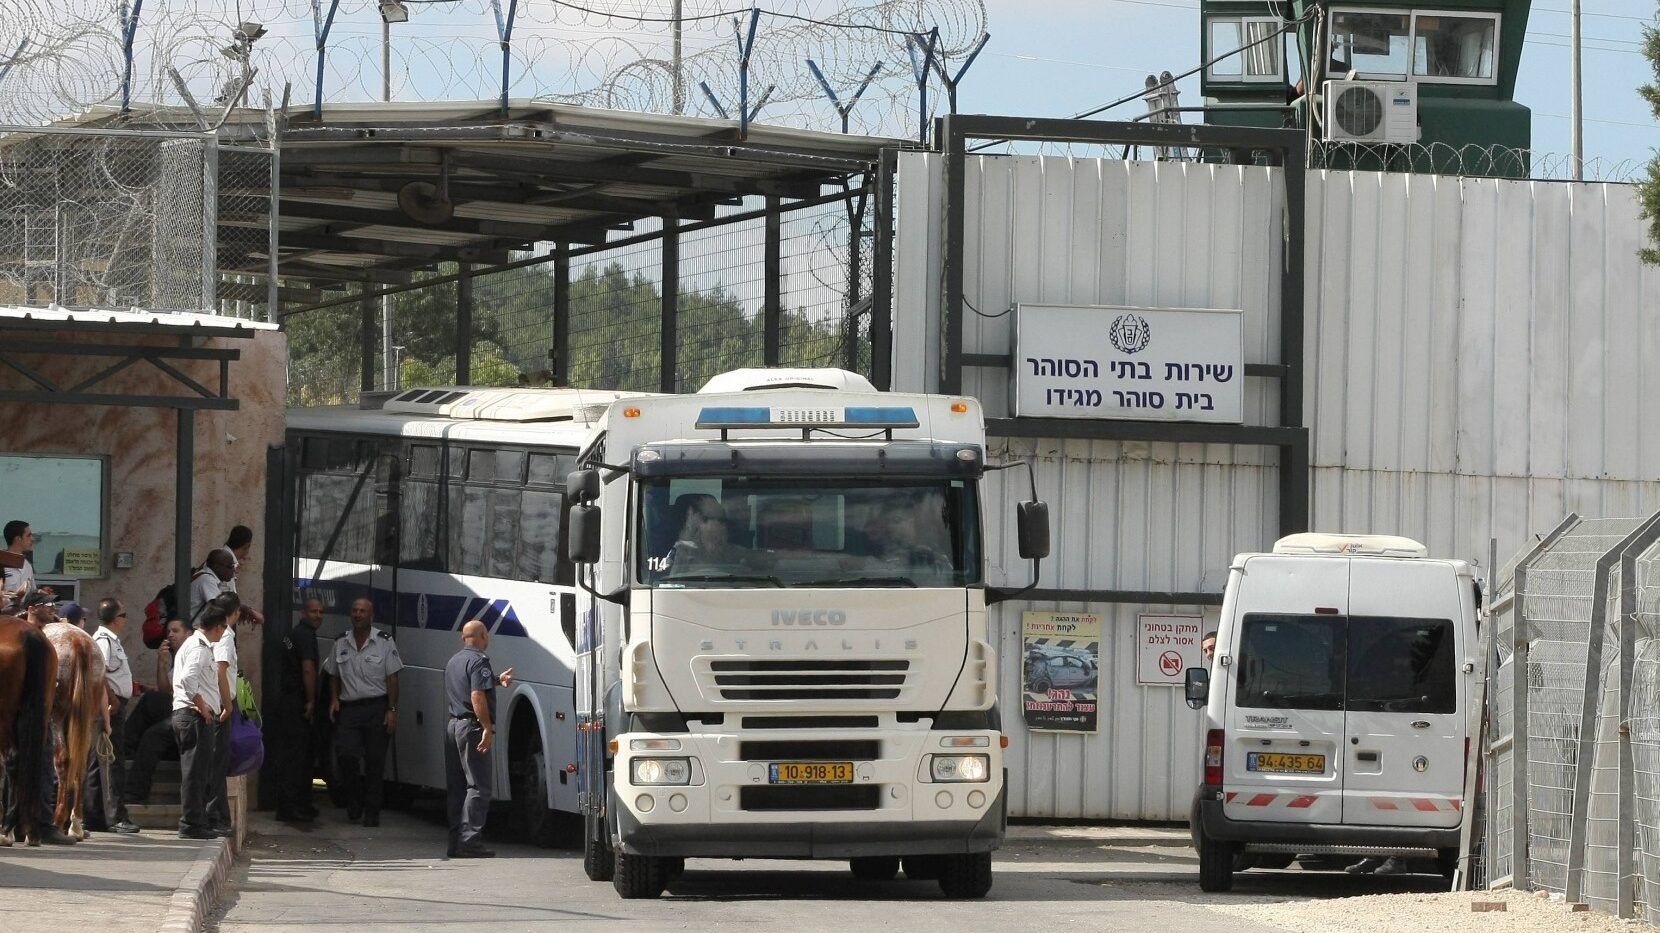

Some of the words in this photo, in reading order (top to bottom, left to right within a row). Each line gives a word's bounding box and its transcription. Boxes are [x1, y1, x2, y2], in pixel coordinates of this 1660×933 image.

[1027, 358, 1098, 378] הסוהר
[1110, 360, 1152, 380] בתי
[1165, 362, 1233, 383] שירות
[1046, 388, 1102, 408] מגידו
[1112, 390, 1164, 409] סוהר
[1175, 392, 1214, 410] בית
[647, 556, 669, 571] 114
[771, 609, 846, 626] IVECO
[1057, 623, 1076, 633] לקחת
[1144, 623, 1173, 632] בטחוני
[1175, 624, 1198, 635] מתקן
[701, 639, 917, 650] STRALIS
[1148, 634, 1171, 644] לצלם
[1173, 636, 1194, 645] אסור
